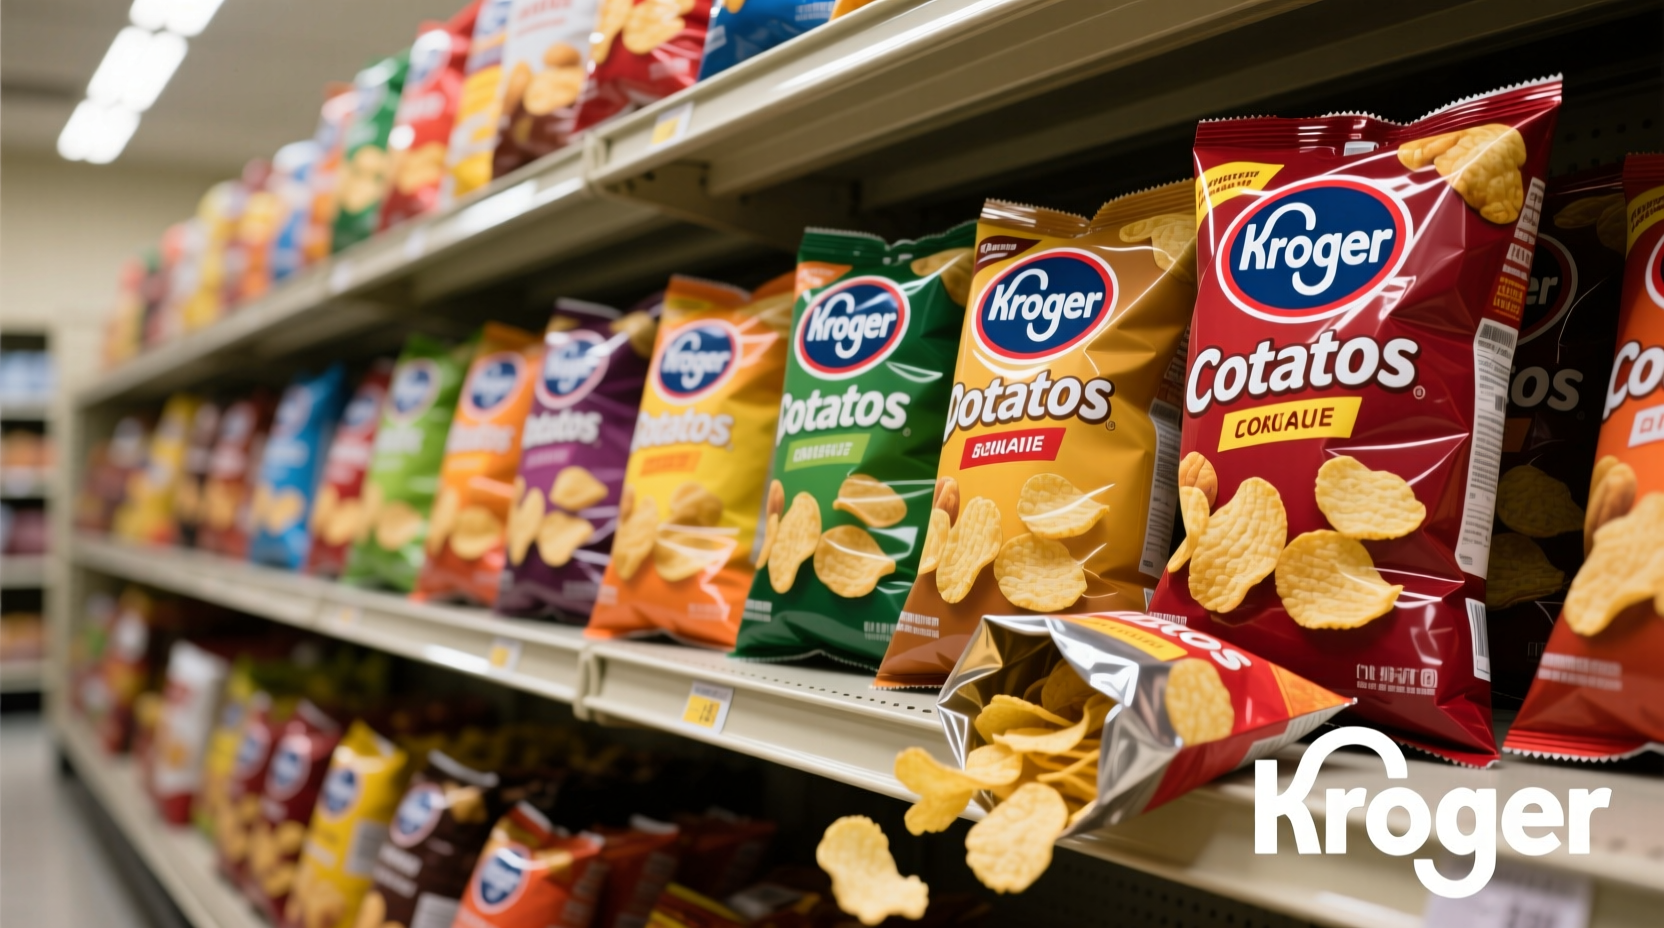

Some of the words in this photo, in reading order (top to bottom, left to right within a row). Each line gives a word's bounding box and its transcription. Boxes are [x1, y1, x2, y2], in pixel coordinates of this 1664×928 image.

[1238, 202, 1394, 296] Kroger
[806, 292, 898, 360] Kroger
[987, 268, 1103, 342] Kroger
[1186, 331, 1419, 414] Cotatos
